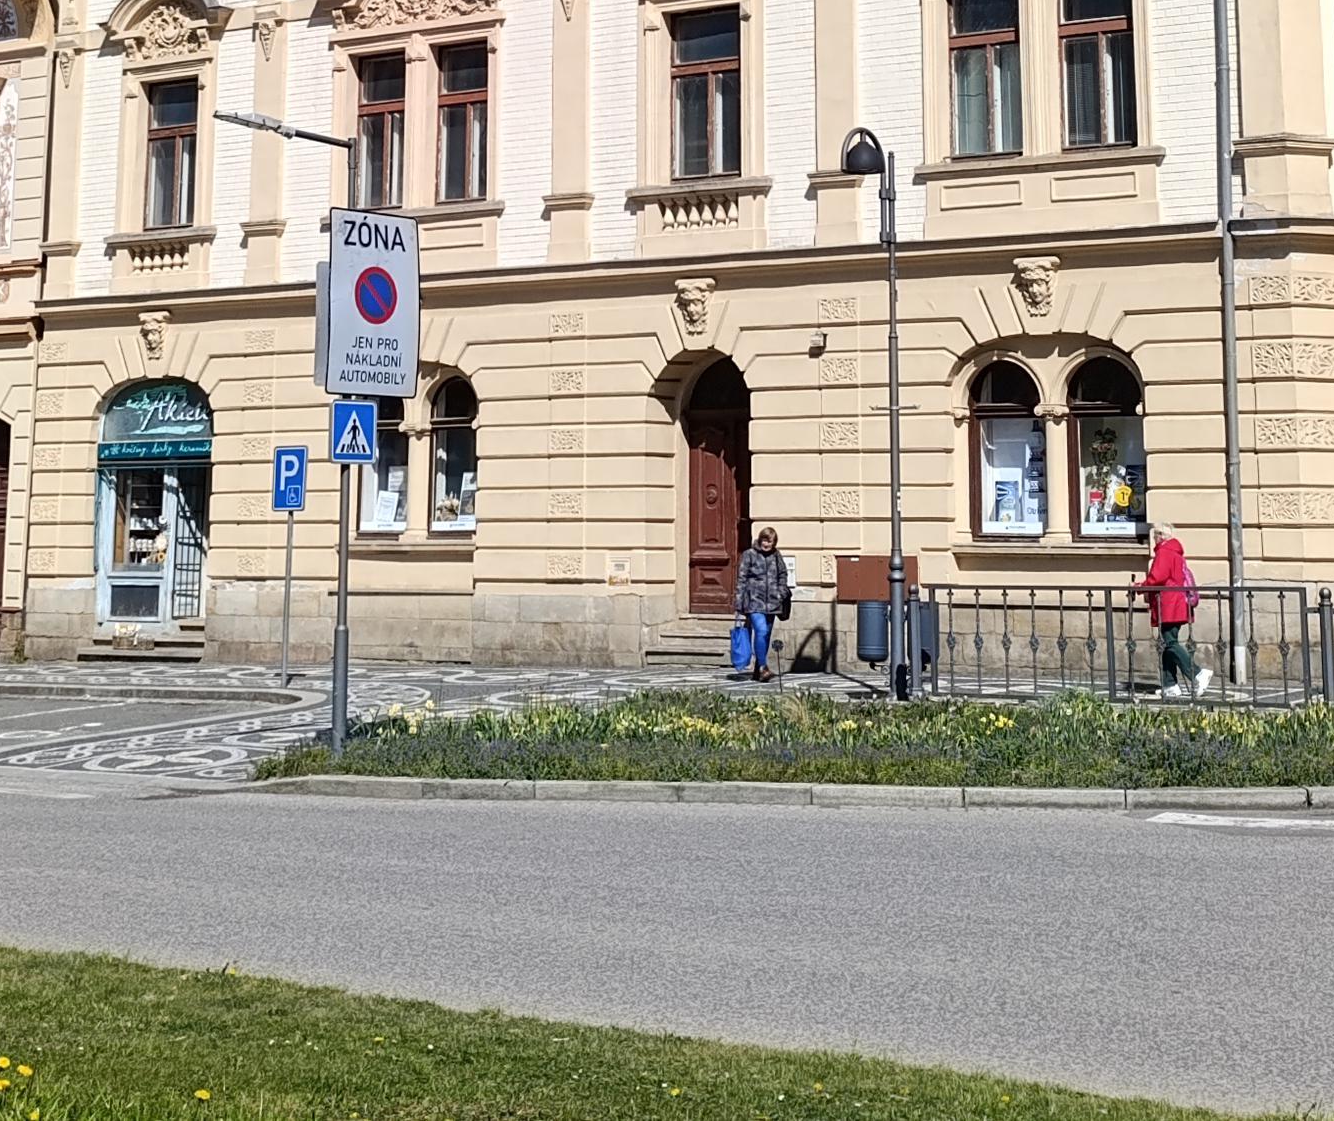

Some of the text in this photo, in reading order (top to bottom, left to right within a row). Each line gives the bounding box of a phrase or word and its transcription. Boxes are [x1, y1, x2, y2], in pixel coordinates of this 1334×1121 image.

[343, 216, 407, 253] ZÓNA
[352, 336, 399, 351] JEN PRO
[345, 351, 403, 369] NÁKLADNÍ
[339, 370, 407, 386] AUTOMOBILY
[279, 454, 299, 491] P
